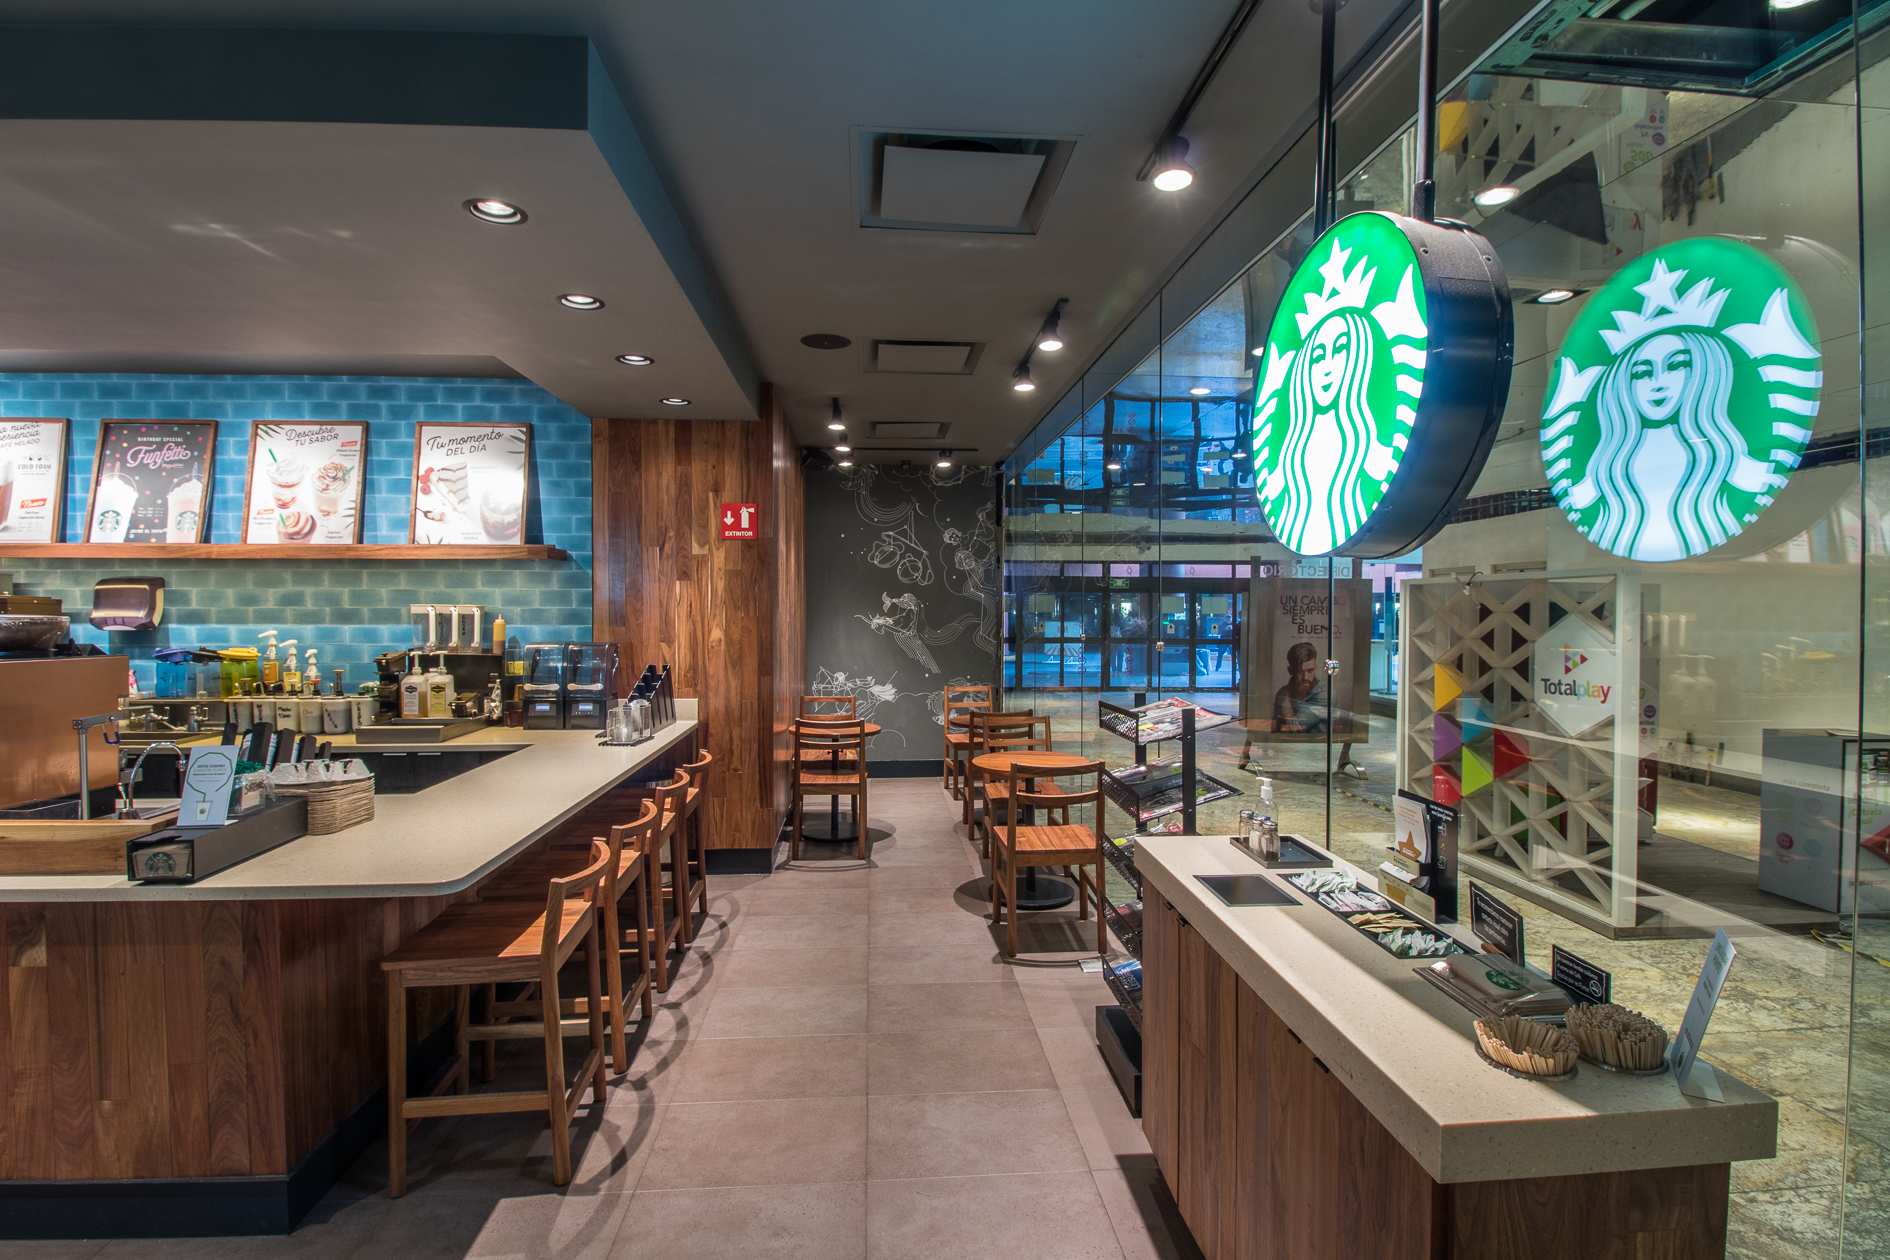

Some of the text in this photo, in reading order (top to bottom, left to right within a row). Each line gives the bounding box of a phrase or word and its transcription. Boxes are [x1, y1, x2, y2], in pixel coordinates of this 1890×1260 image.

[285, 425, 337, 441] Descubre
[295, 433, 340, 447] TU SABOR
[426, 428, 505, 451] Tu momento
[14, 438, 41, 447] HELADO
[126, 443, 191, 469] Funfetti
[446, 443, 487, 457] DEL DÍA
[1280, 595, 1298, 606] UN
[1291, 615, 1305, 625] ES
[1540, 678, 1611, 704] Totalplay
[1798, 779, 1830, 792] completa
[1848, 808, 1883, 818] ¡Ctrata
